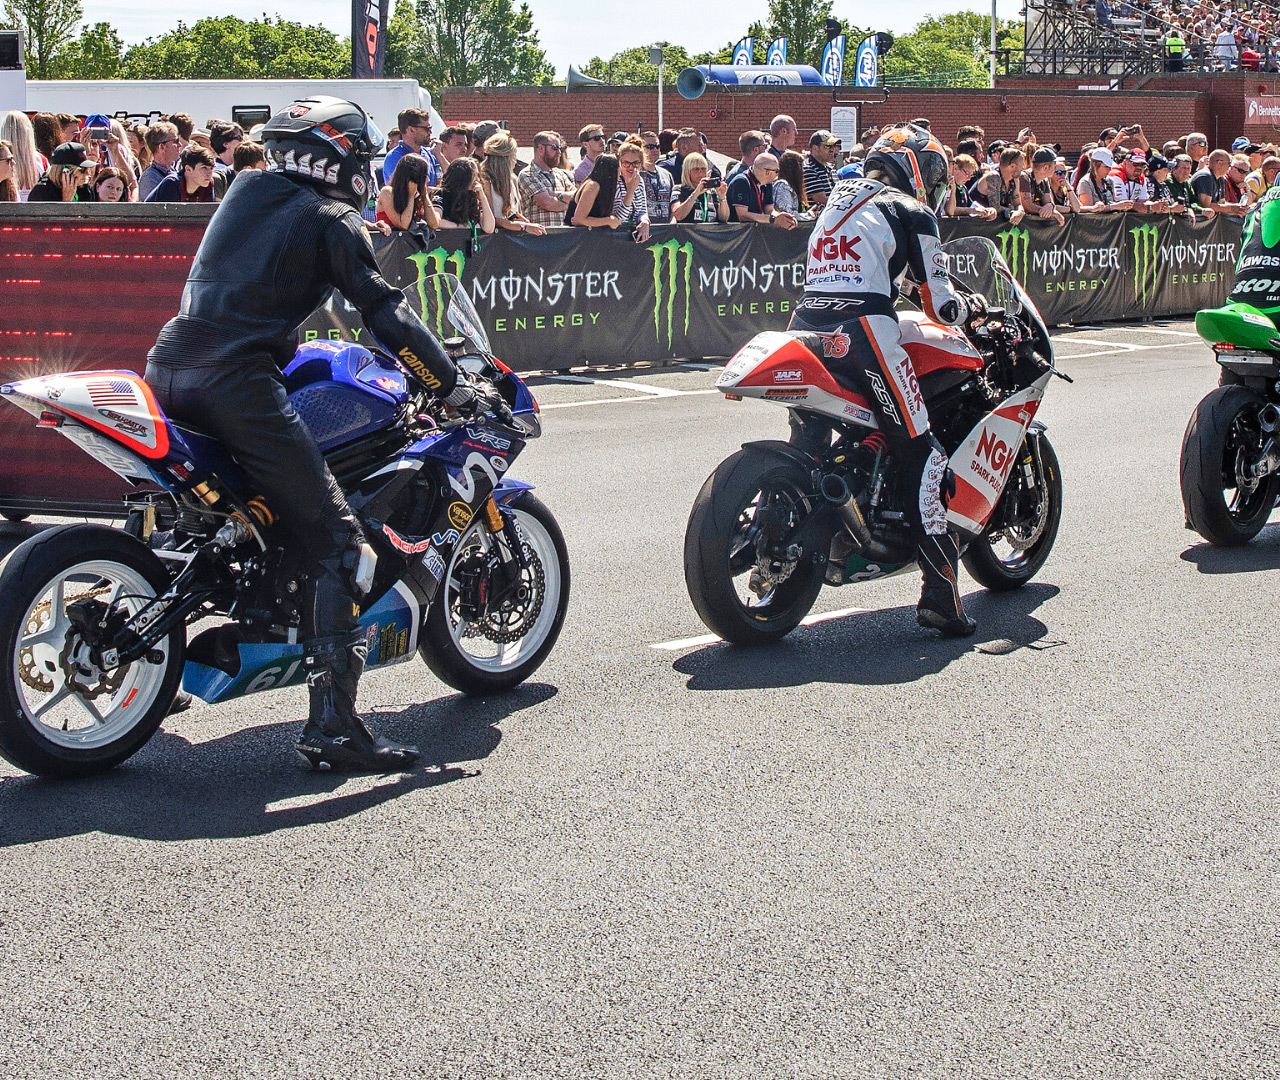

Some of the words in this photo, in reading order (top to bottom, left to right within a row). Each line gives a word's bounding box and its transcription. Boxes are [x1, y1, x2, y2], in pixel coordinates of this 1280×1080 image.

[1258, 105, 1280, 116] Bennetts
[352, 176, 365, 193] BELL
[807, 235, 862, 266] NGK
[1032, 244, 1121, 277] MONSTER
[1160, 239, 1237, 271] MONSTER
[698, 258, 807, 297] MONSTE
[807, 264, 828, 275] PARK
[827, 263, 862, 273] PLUGS
[1172, 272, 1225, 285] ENERGY
[471, 267, 624, 310] MONSTER
[1045, 278, 1109, 294] ENERGY
[796, 296, 866, 311] RST
[305, 327, 363, 343] RGY
[495, 312, 602, 332] ENERGY
[398, 346, 442, 391] vanson
[900, 356, 925, 412] NGK
[864, 368, 902, 426] RST
[894, 365, 909, 392] SPARK
[904, 391, 917, 417] PLUGS
[970, 460, 991, 481] SPARK
[382, 524, 431, 555] RACING
[512, 519, 526, 545] ROCK
[521, 544, 531, 563] OIL
[244, 659, 302, 694] 61
